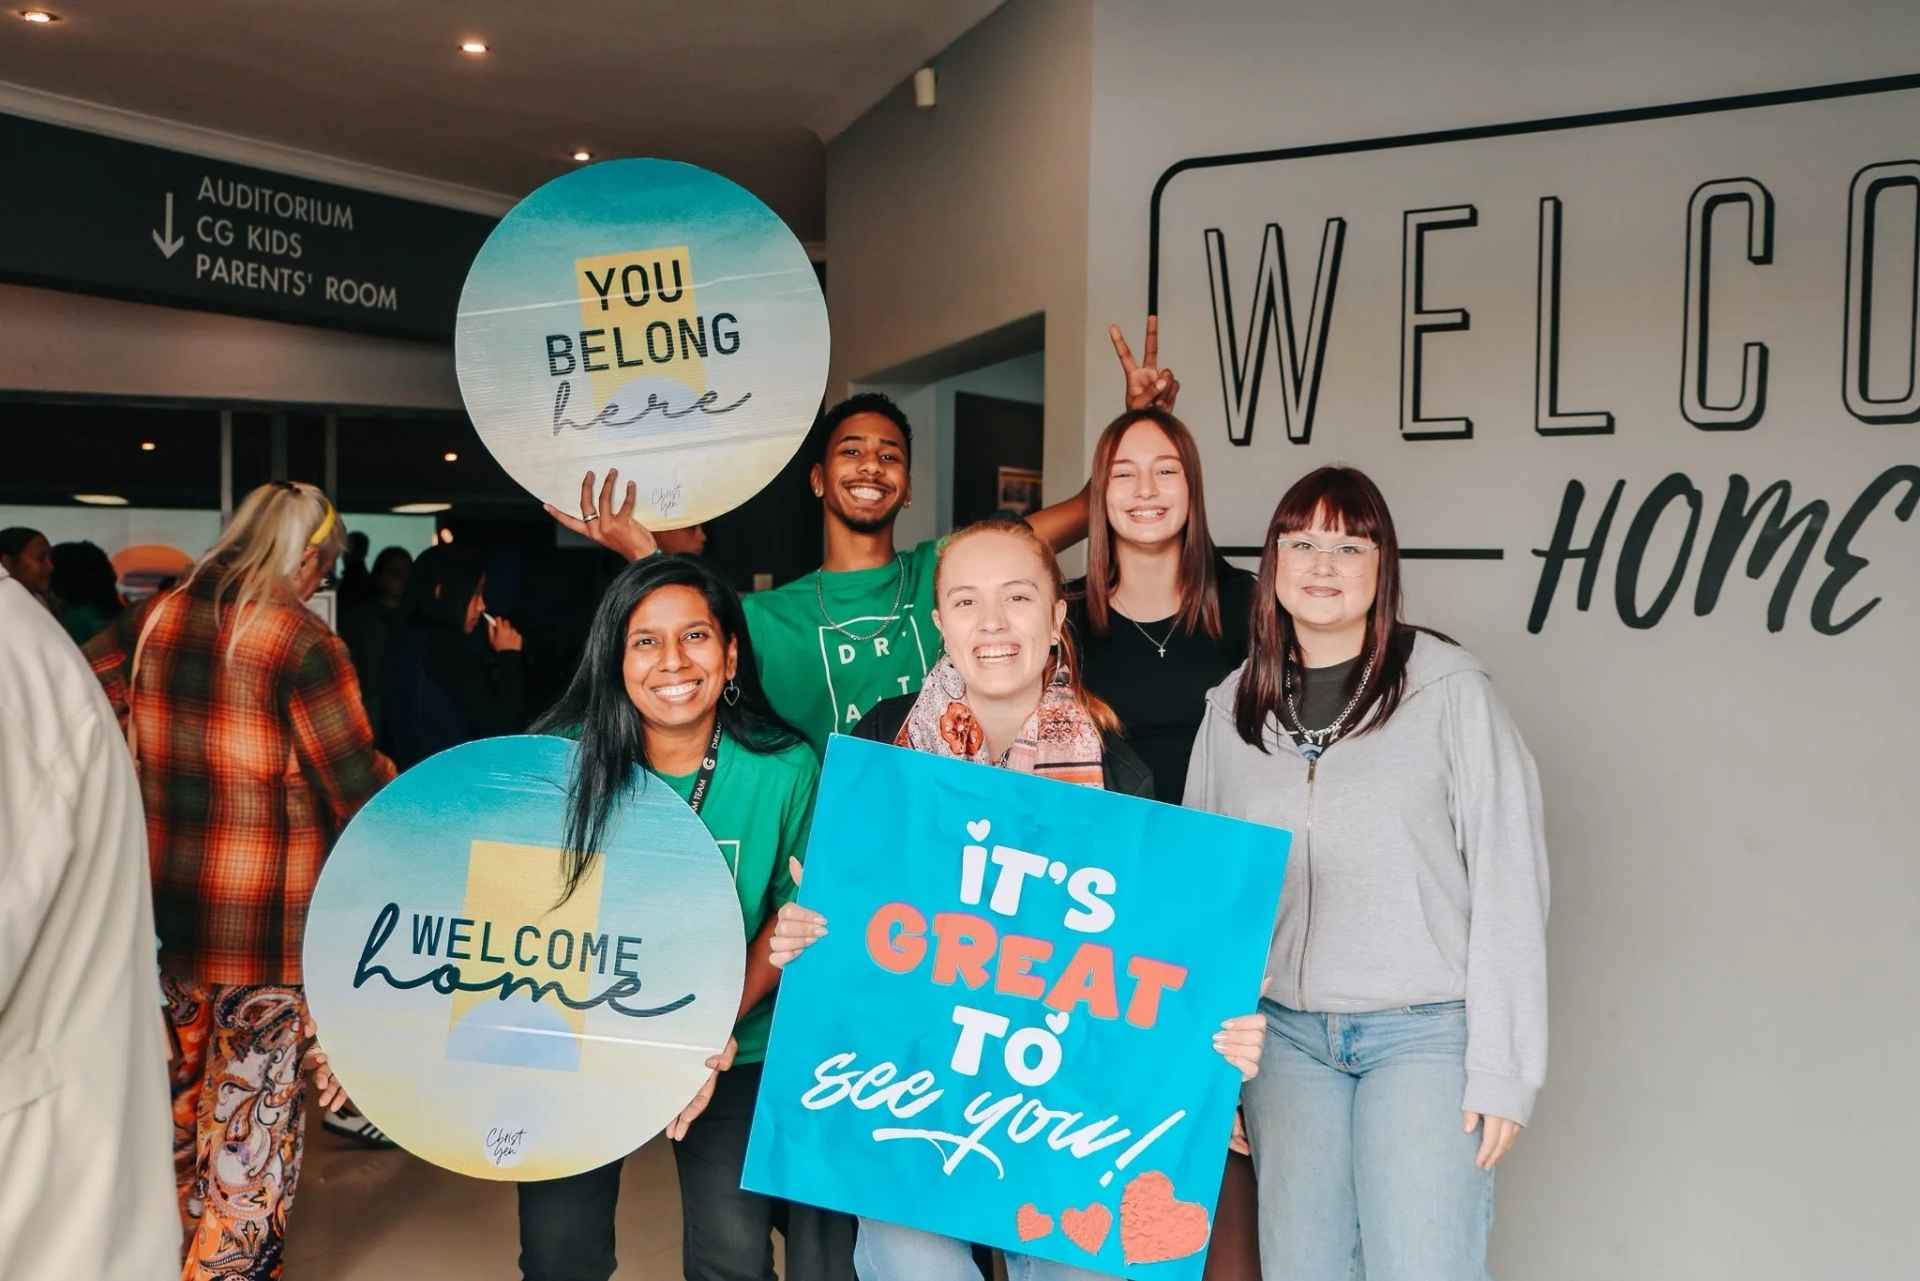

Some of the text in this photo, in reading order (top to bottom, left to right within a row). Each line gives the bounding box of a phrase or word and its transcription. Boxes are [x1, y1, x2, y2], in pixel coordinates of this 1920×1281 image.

[198, 175, 354, 231] AUDITORIUM
[197, 215, 303, 259] CG KIDS
[196, 253, 399, 311] PARENTS' ROOM
[584, 259, 684, 312] YOU
[546, 311, 742, 377] BELONG
[552, 380, 753, 436] here
[1526, 463, 1920, 637] HOME
[352, 902, 697, 1018] home
[411, 913, 643, 979] WELCOME
[865, 901, 1189, 1030] GREAT
[951, 1005, 1071, 1087] TO
[800, 1051, 1187, 1188] see you!
